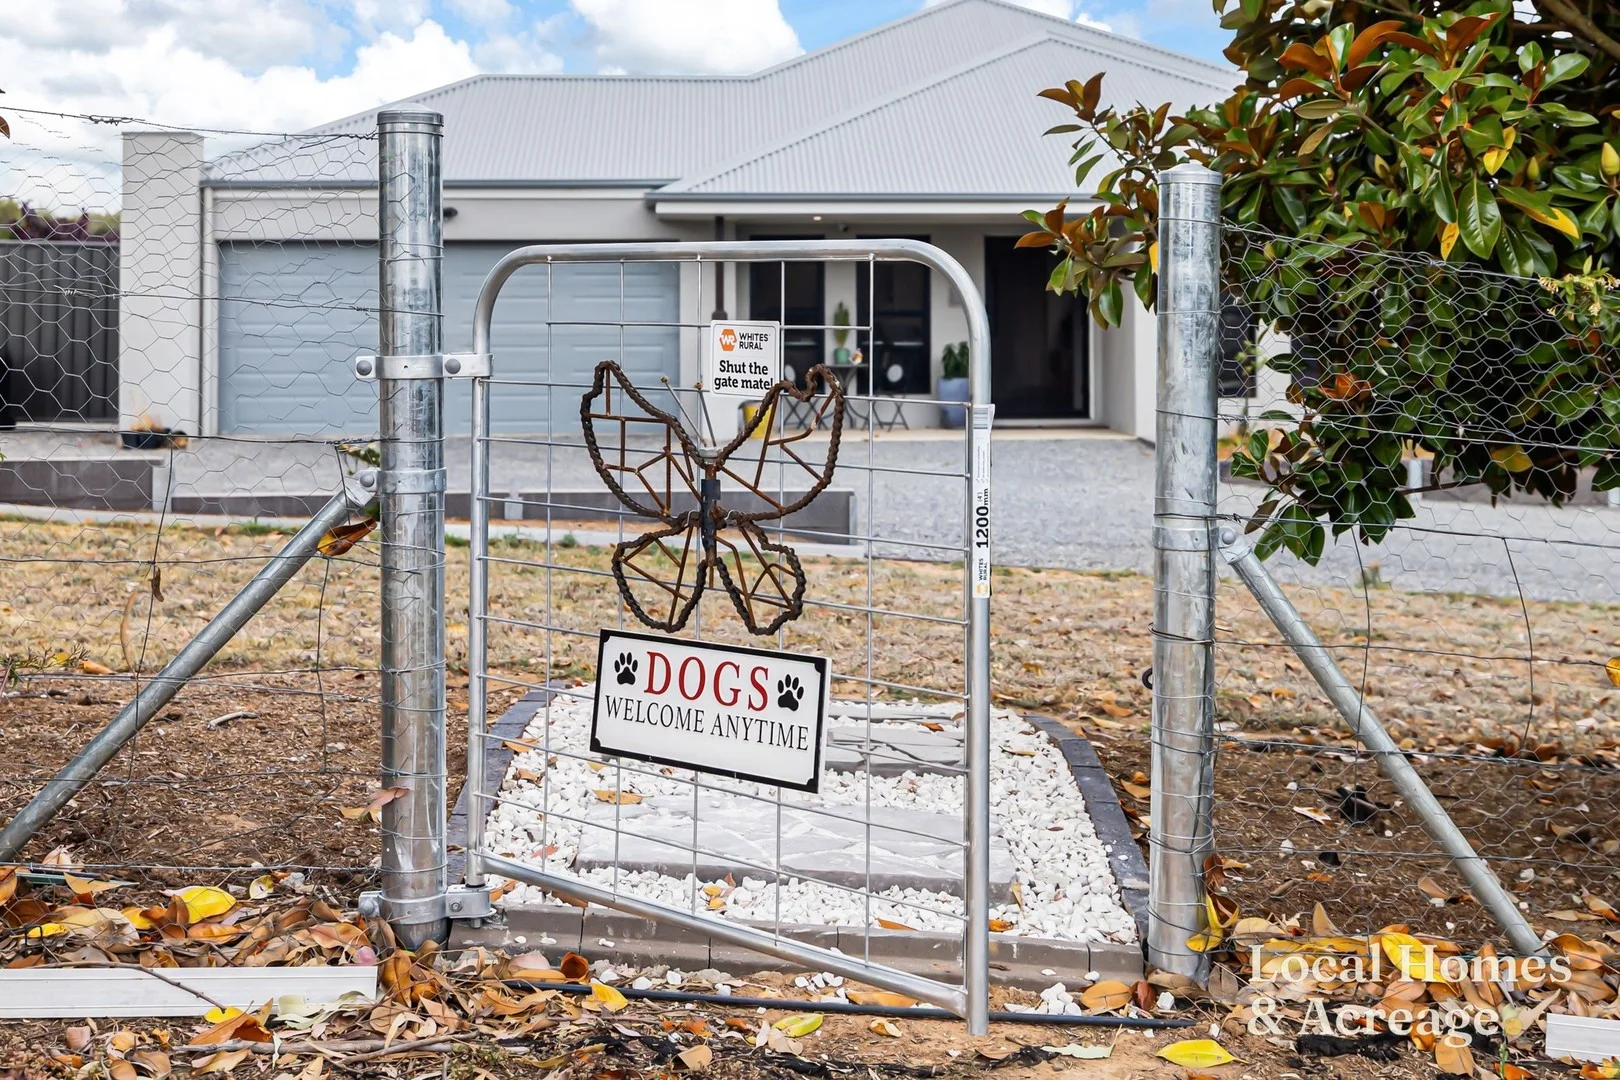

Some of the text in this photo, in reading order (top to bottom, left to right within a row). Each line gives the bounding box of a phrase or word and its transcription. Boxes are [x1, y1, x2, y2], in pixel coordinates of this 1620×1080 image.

[739, 333, 769, 342] WHITES
[739, 341, 763, 350] RURAL
[719, 360, 769, 375] Shut the
[714, 376, 739, 390] gate
[644, 651, 769, 712] DOGS
[604, 694, 809, 751] WELCOME ANYTIME
